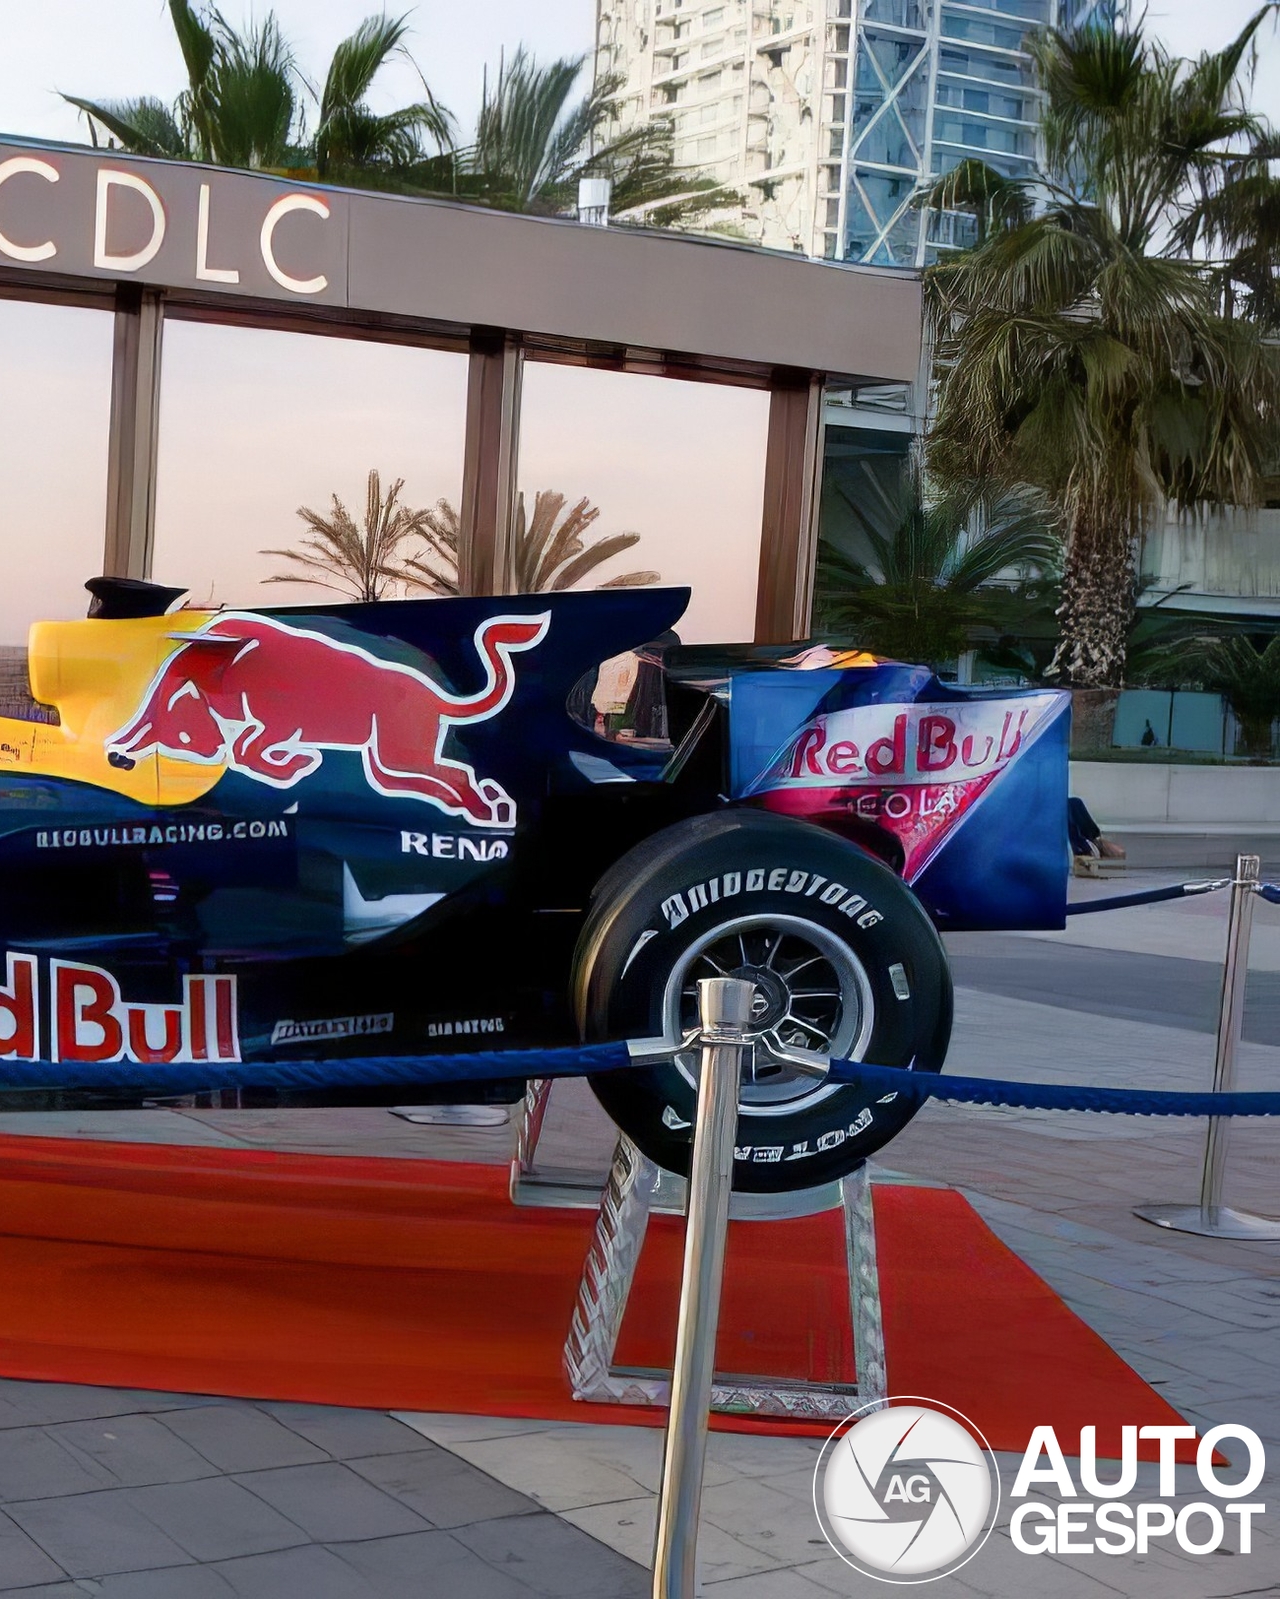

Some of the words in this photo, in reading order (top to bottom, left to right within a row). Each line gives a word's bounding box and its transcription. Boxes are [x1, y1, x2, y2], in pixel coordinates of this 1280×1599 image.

[790, 713, 908, 779] Red
[916, 708, 1029, 773] Bull
[856, 784, 962, 819] COLA
[50, 957, 242, 1063] Bull
